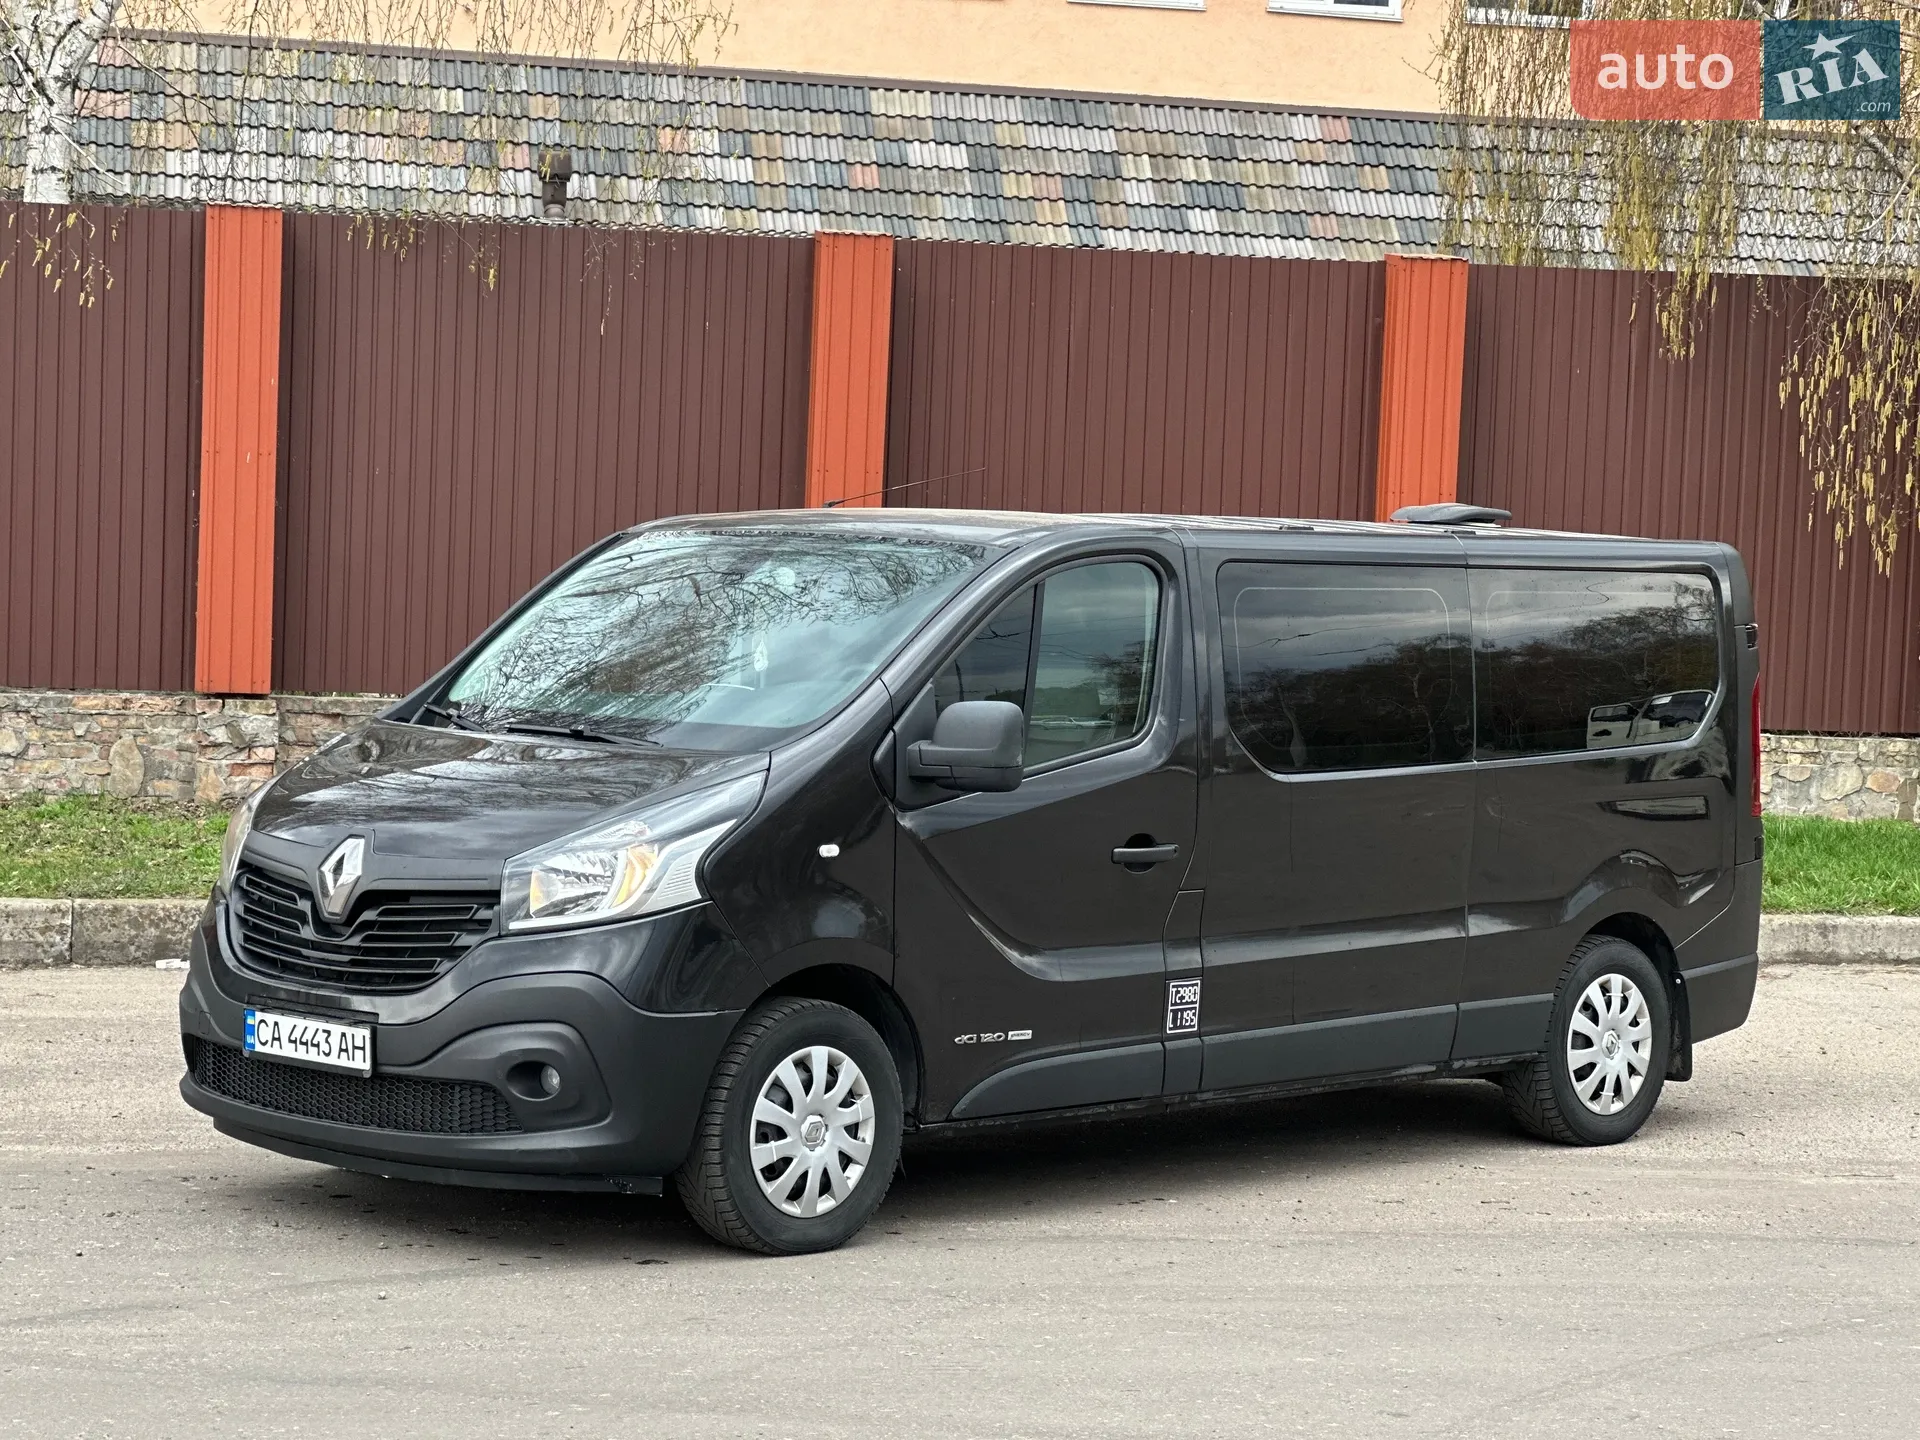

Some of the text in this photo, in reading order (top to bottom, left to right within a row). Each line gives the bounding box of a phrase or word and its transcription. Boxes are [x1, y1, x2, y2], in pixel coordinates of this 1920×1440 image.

[246, 1034, 255, 1045] UA
[256, 1018, 367, 1064] CA 4443 AH
[980, 1032, 1006, 1043] 120
